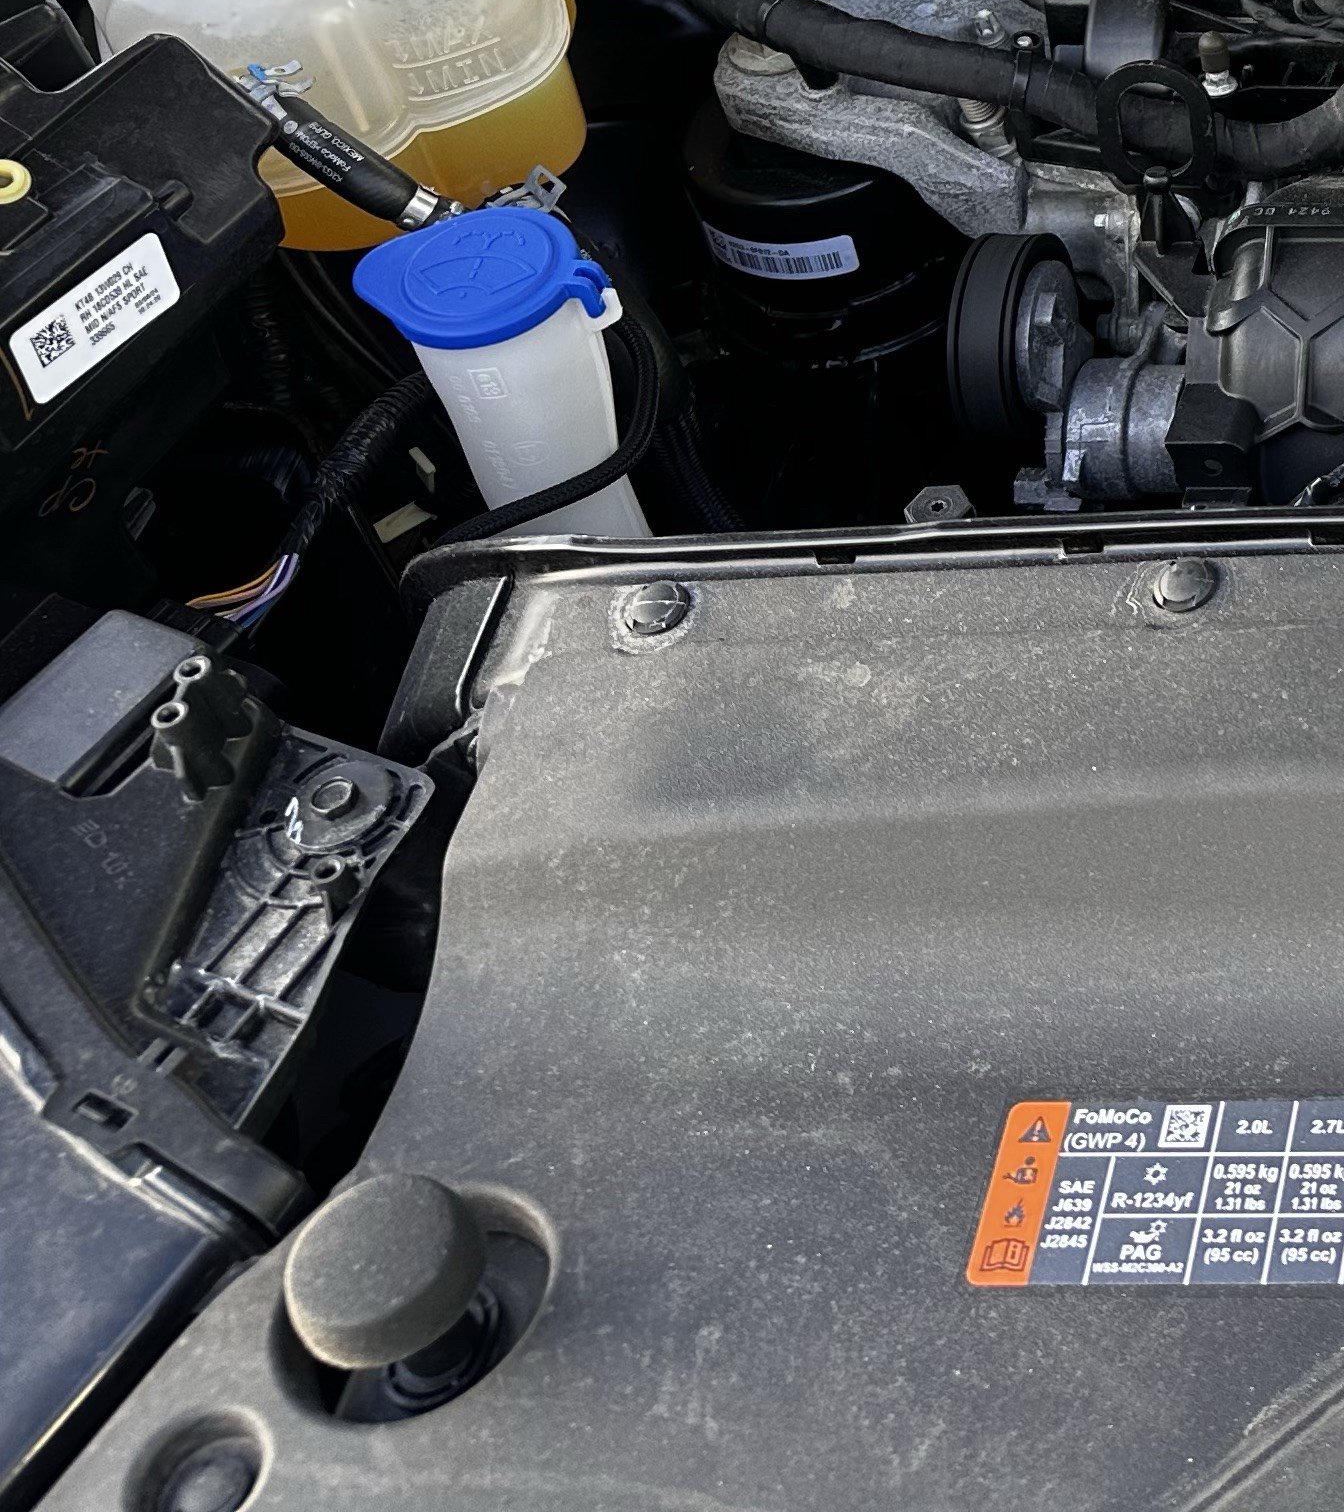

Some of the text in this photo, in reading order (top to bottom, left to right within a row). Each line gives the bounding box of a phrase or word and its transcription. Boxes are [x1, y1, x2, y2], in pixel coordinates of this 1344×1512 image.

[122, 283, 146, 306] SPORT
[1073, 1109, 1153, 1124] FoMoCo
[1236, 1119, 1273, 1135] 2.0L
[1064, 1133, 1146, 1152] (GWP 4)
[1213, 1163, 1279, 1183] 0.595 kg
[1289, 1163, 1332, 1179] 0.595
[1059, 1180, 1096, 1194] SAE
[1224, 1182, 1262, 1195] 21 oz
[1300, 1182, 1338, 1195] 21 oz
[1053, 1198, 1093, 1212] J639
[1111, 1192, 1194, 1211] R-1234yf
[1215, 1197, 1266, 1210] 1.31 lbs
[1291, 1197, 1342, 1210] 1.31 lbs
[1044, 1216, 1092, 1230] J2842
[1040, 1235, 1088, 1248] J2845
[1202, 1229, 1227, 1243] 3.2
[1244, 1231, 1266, 1243] oz
[1279, 1229, 1305, 1243] 3.2
[1321, 1231, 1342, 1243] oz
[1119, 1245, 1162, 1260] PAG
[1203, 1247, 1259, 1265] (95 cc)
[1281, 1247, 1336, 1265] (95 cc)
